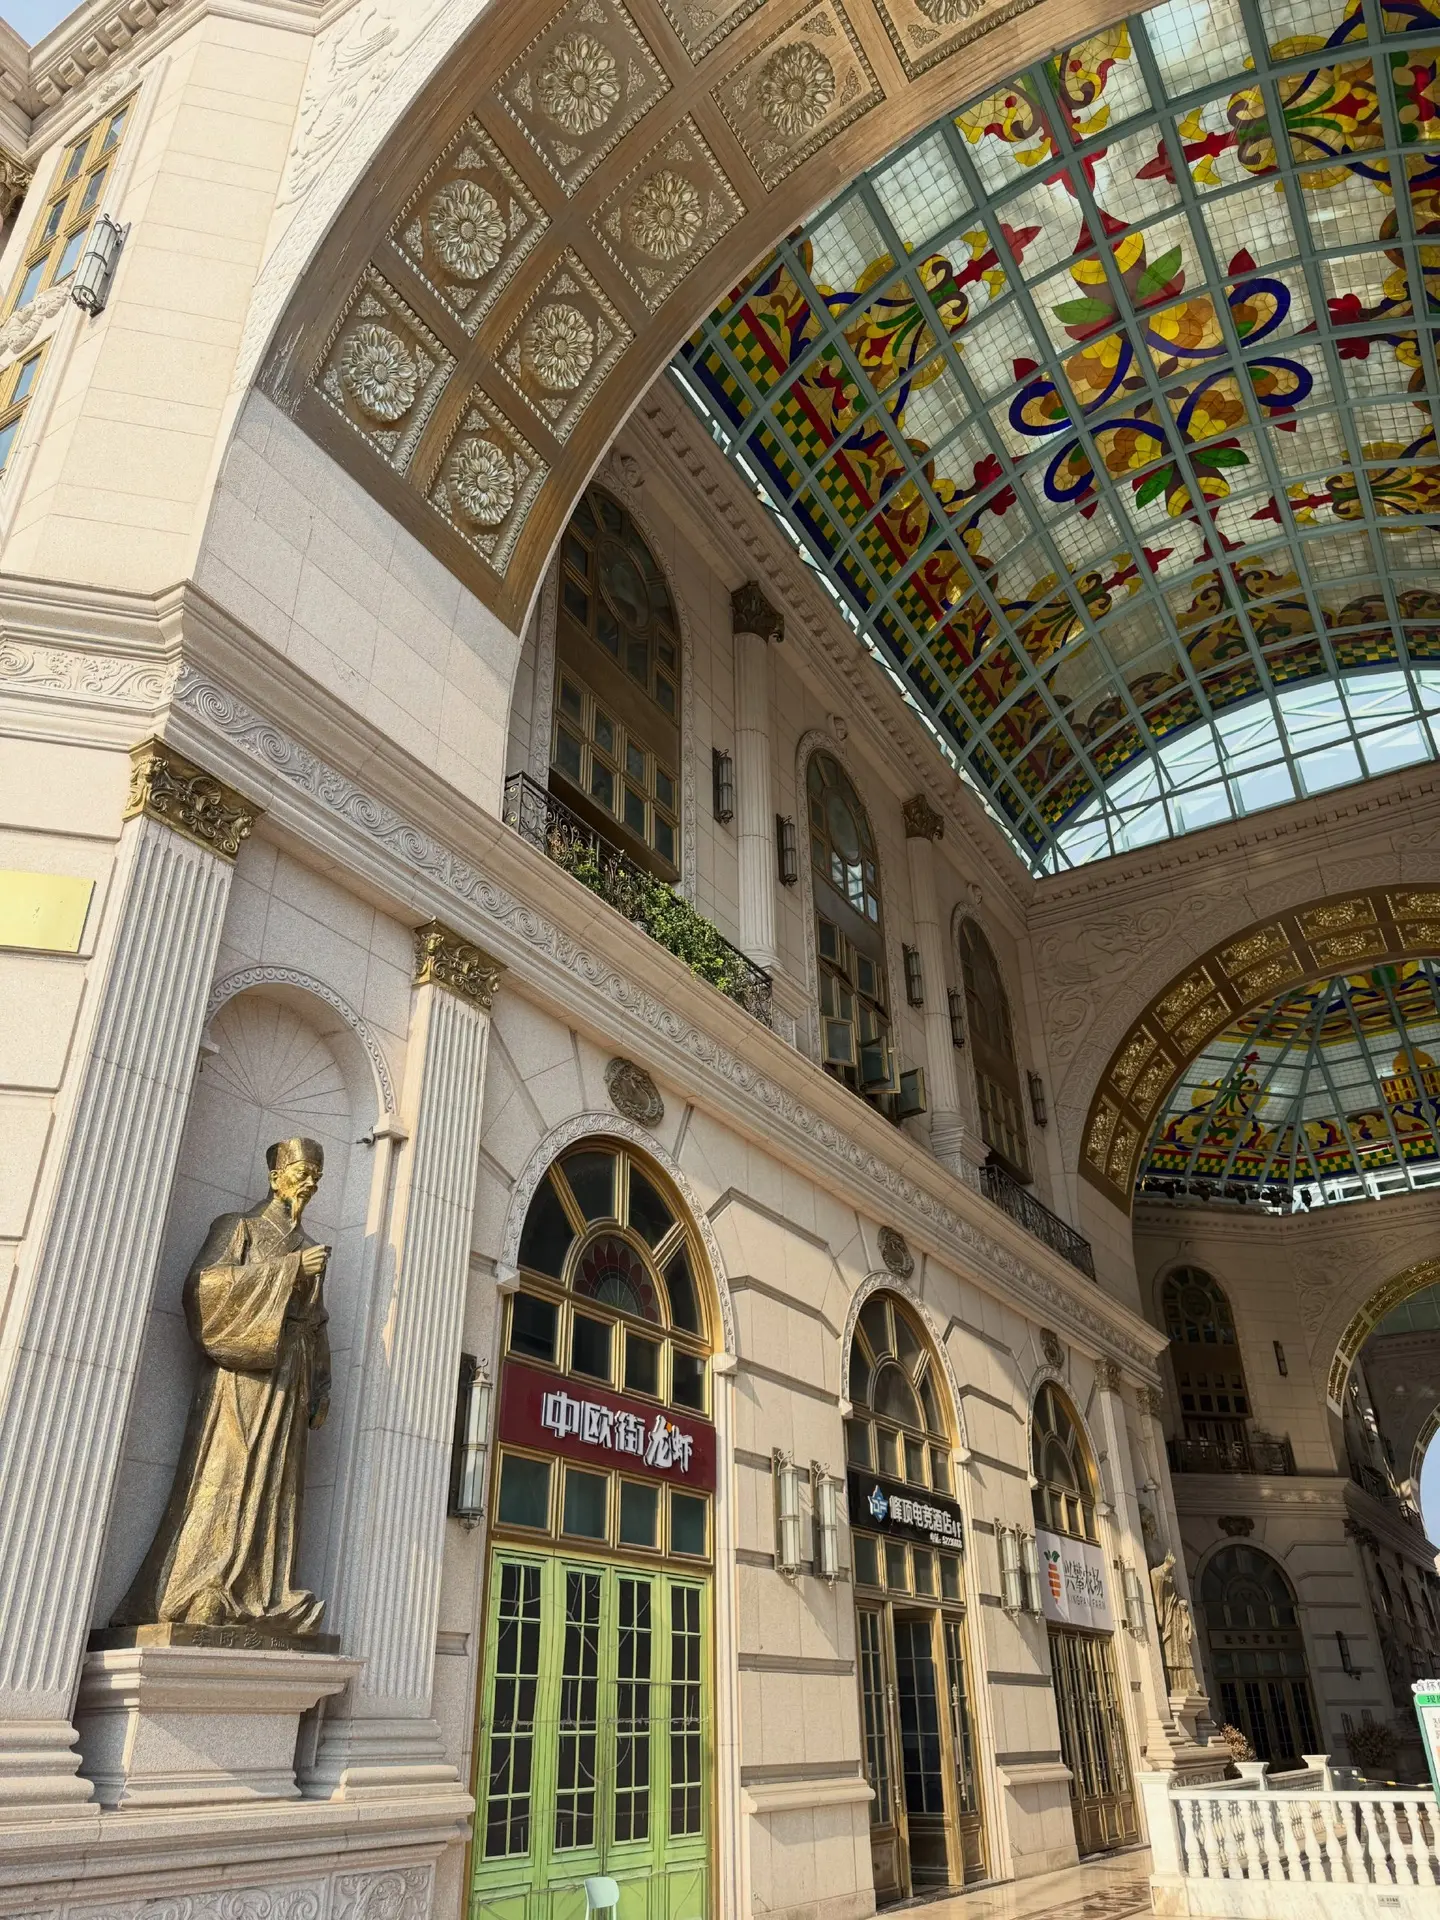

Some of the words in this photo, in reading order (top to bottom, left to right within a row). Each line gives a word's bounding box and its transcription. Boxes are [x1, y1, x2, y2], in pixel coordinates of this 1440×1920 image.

[541, 1390, 693, 1473] 中欧街龙虾
[193, 1628, 262, 1649] 李时珍
